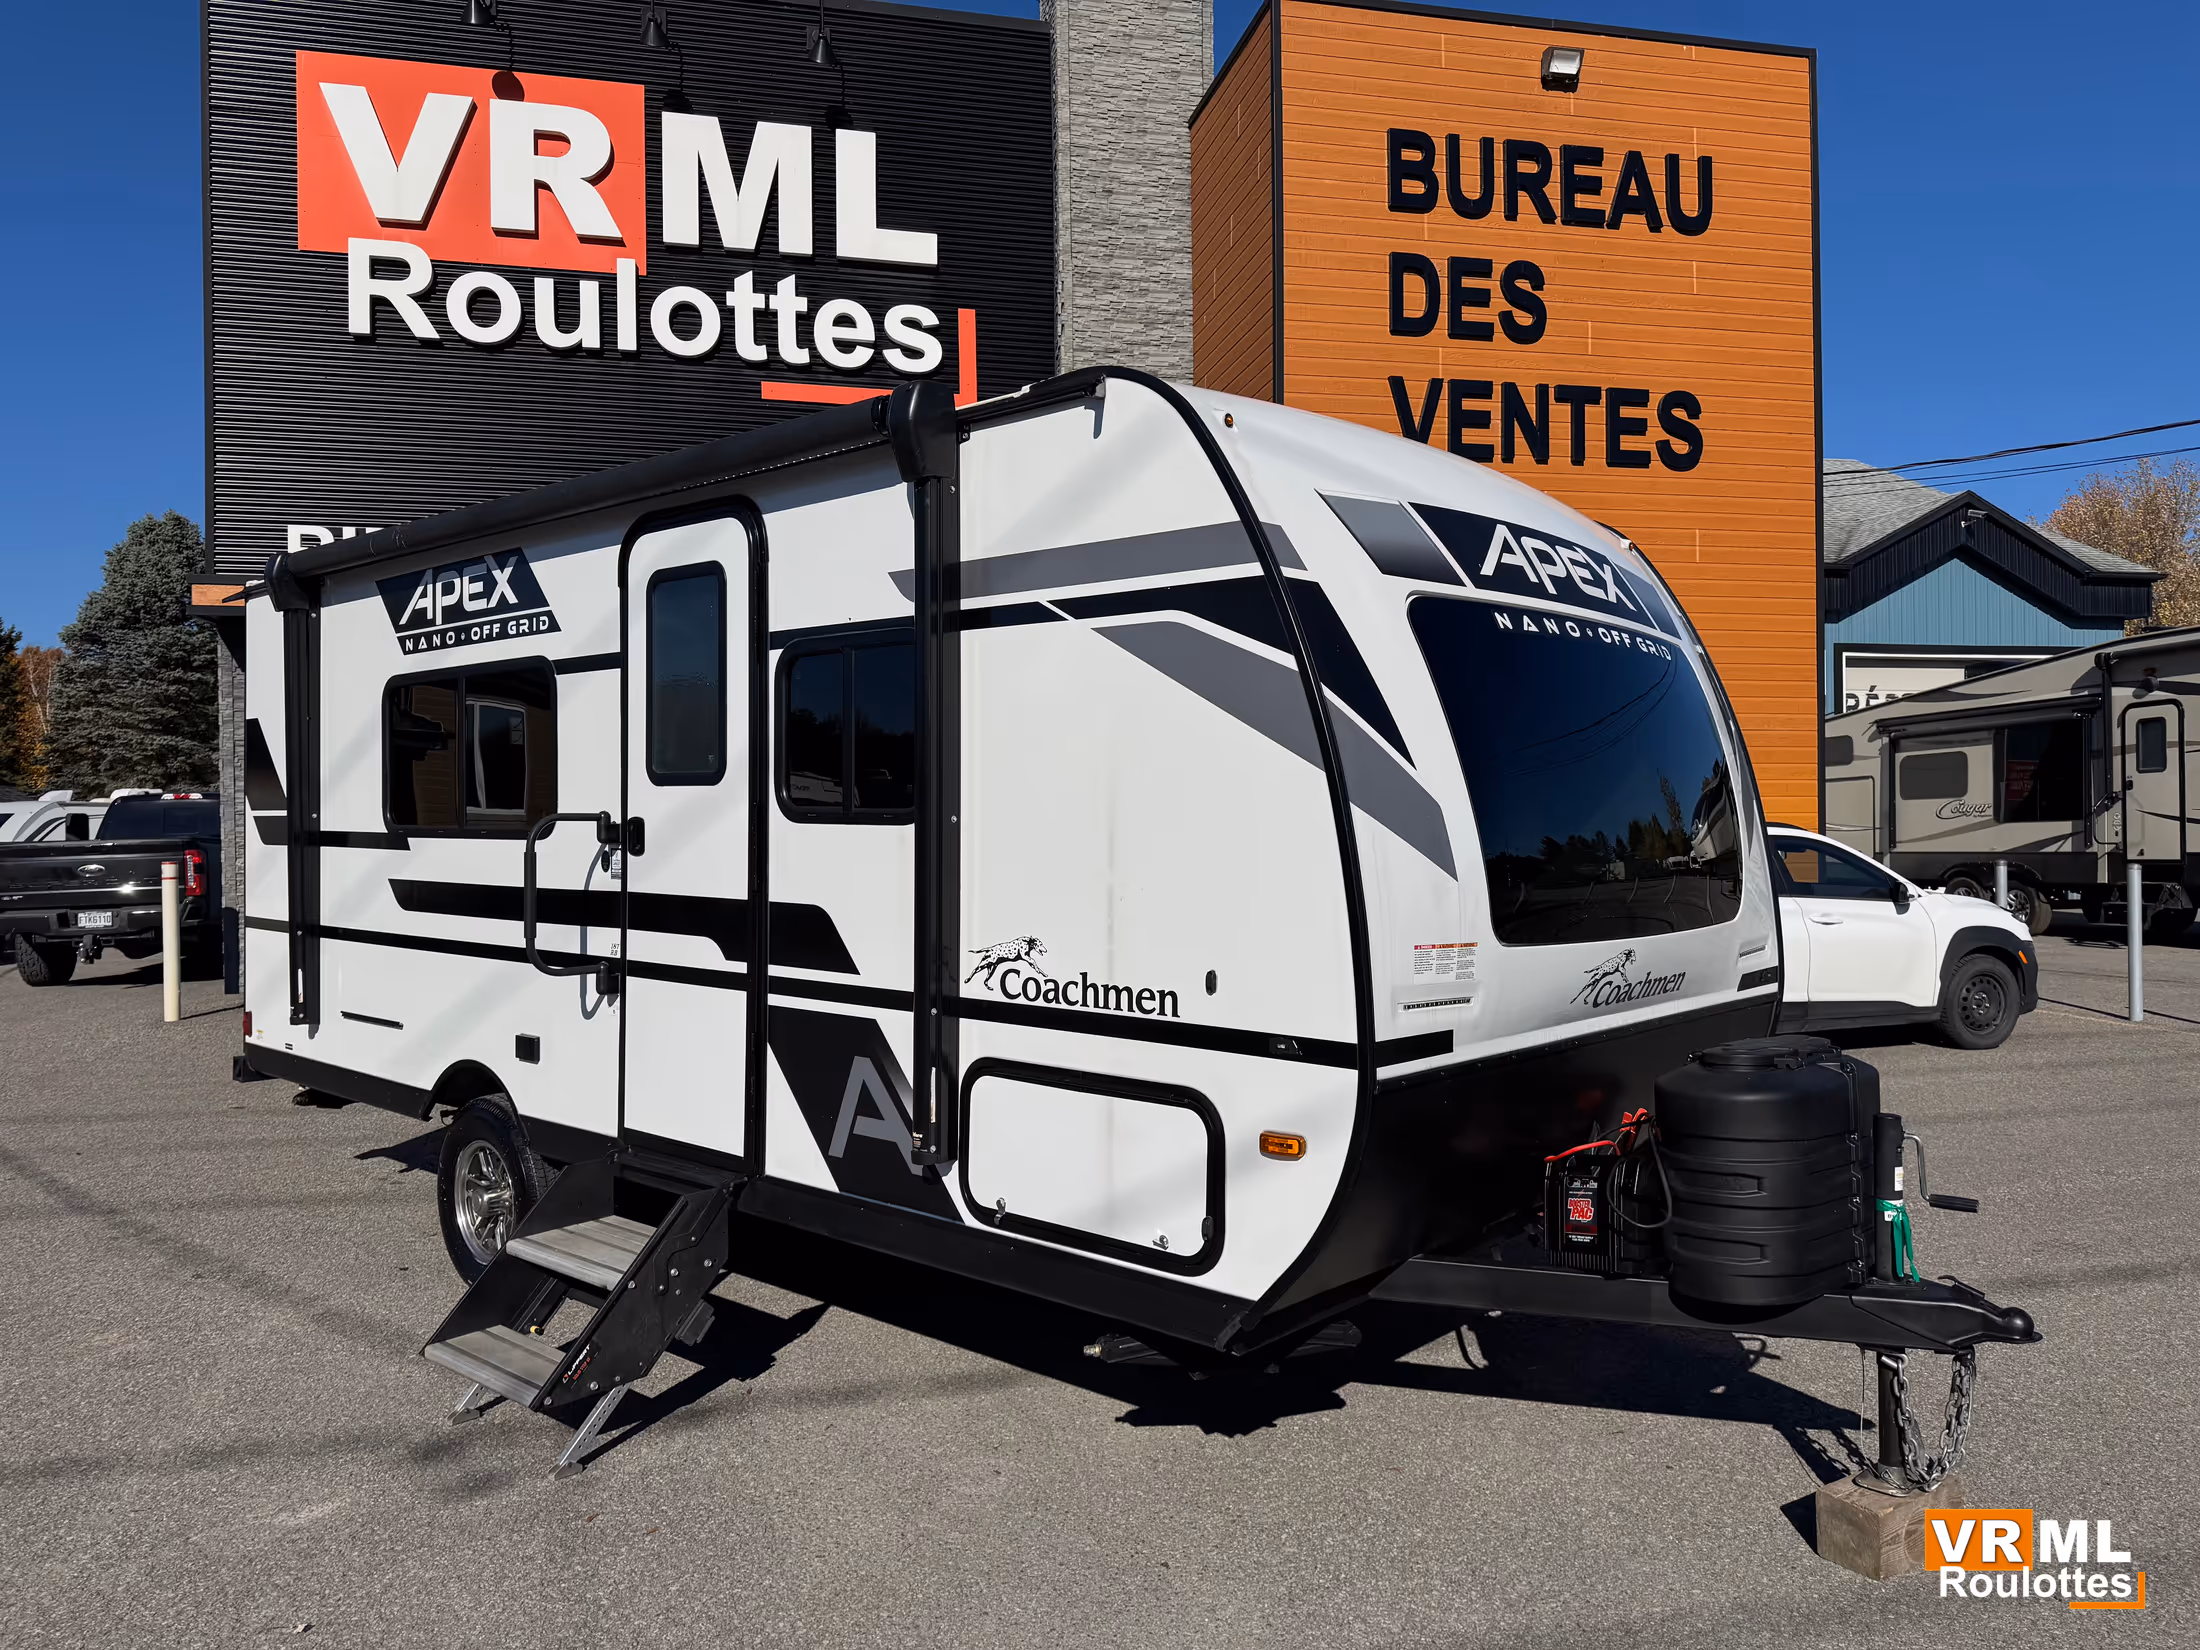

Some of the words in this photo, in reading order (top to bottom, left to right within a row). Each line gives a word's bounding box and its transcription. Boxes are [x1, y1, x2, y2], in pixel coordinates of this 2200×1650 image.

[1387, 128, 1712, 236] BUREAU
[348, 237, 942, 373] Roulottes
[1388, 251, 1547, 344] DES
[1388, 375, 1704, 472] VENTES
[399, 555, 518, 625] APEX
[1480, 524, 1637, 611] APEX
[405, 631, 456, 652] NANO
[470, 623, 501, 641] OFF
[507, 616, 549, 635] GRID
[1494, 611, 1581, 638] NANO
[1597, 627, 1632, 648] OFF
[1636, 637, 1672, 661] GRID
[1936, 799, 1992, 820] Cougar
[1000, 968, 1180, 1018] Coachmen
[1592, 971, 1686, 1008] Coachmen
[1570, 1206, 1594, 1221] PAC
